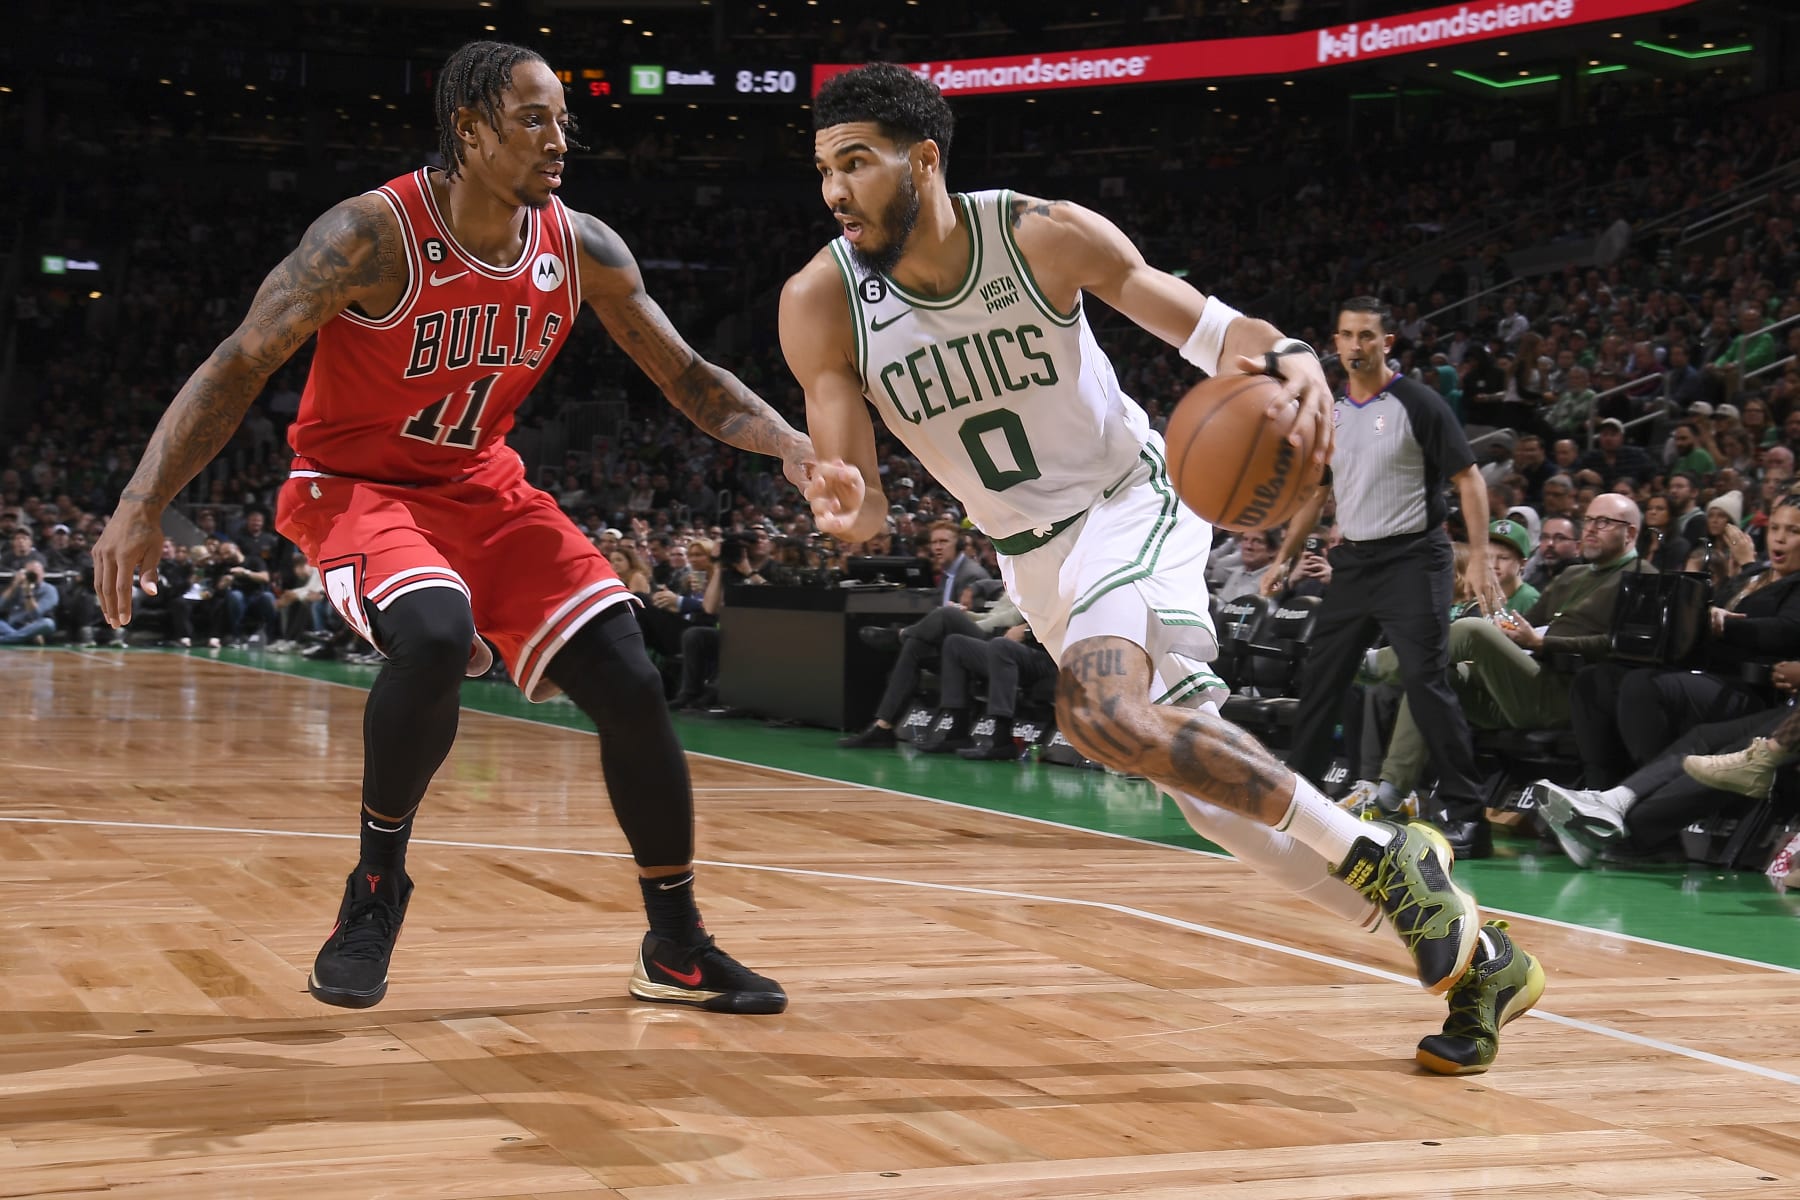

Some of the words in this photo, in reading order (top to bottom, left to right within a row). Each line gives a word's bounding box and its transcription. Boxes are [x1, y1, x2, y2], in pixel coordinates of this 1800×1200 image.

[1361, 0, 1574, 53] demandscience
[634, 70, 661, 89] TD
[666, 70, 715, 86] Bank
[736, 69, 796, 94] 8:50
[933, 55, 1146, 90] demandscience
[426, 241, 442, 261] 6
[865, 279, 881, 301] 6
[979, 275, 1016, 302] VISTA
[985, 292, 1021, 314] PRINT
[403, 303, 563, 379] BULLS
[879, 324, 1059, 425] CELTICS
[400, 372, 503, 450] 11
[958, 407, 1042, 493] 0
